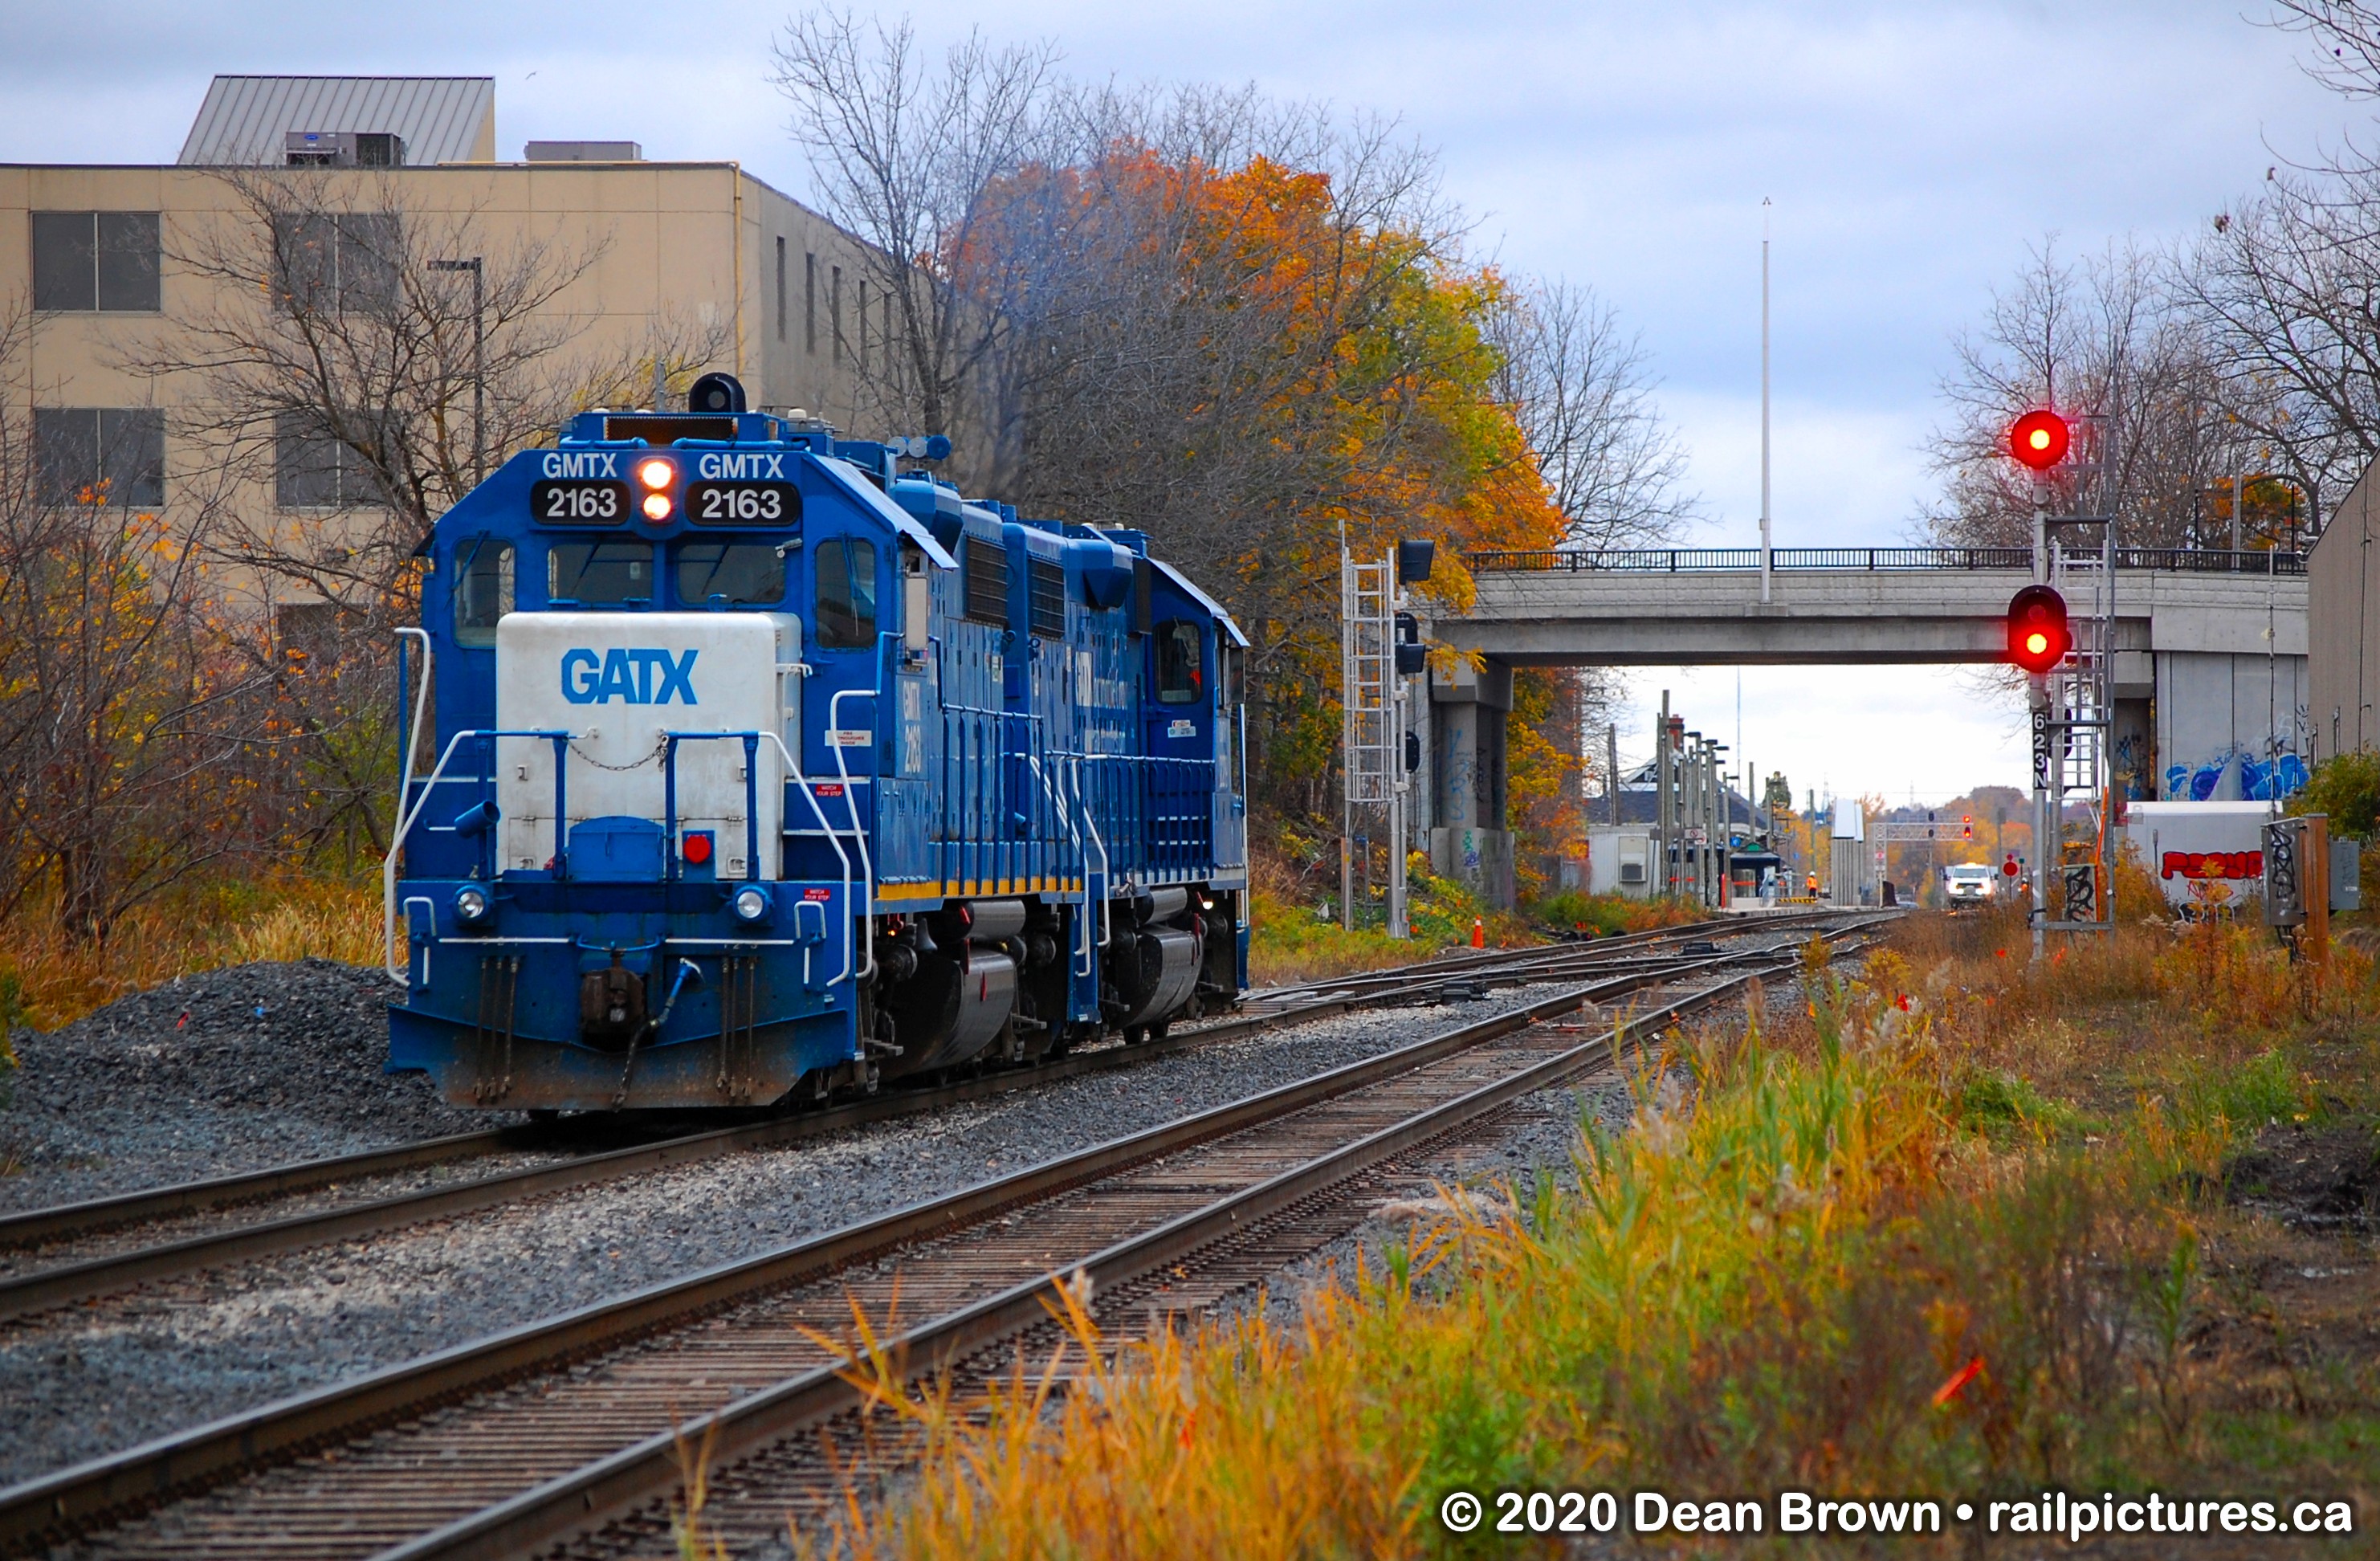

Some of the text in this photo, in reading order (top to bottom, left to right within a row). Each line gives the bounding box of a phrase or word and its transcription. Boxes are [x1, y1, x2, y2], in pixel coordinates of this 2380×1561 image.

[542, 453, 617, 479] GMTX
[699, 454, 785, 479] GMTX
[547, 488, 617, 518] 2163
[702, 489, 781, 520] 2163
[561, 649, 699, 704] GATX
[2034, 713, 2048, 788] 623N
